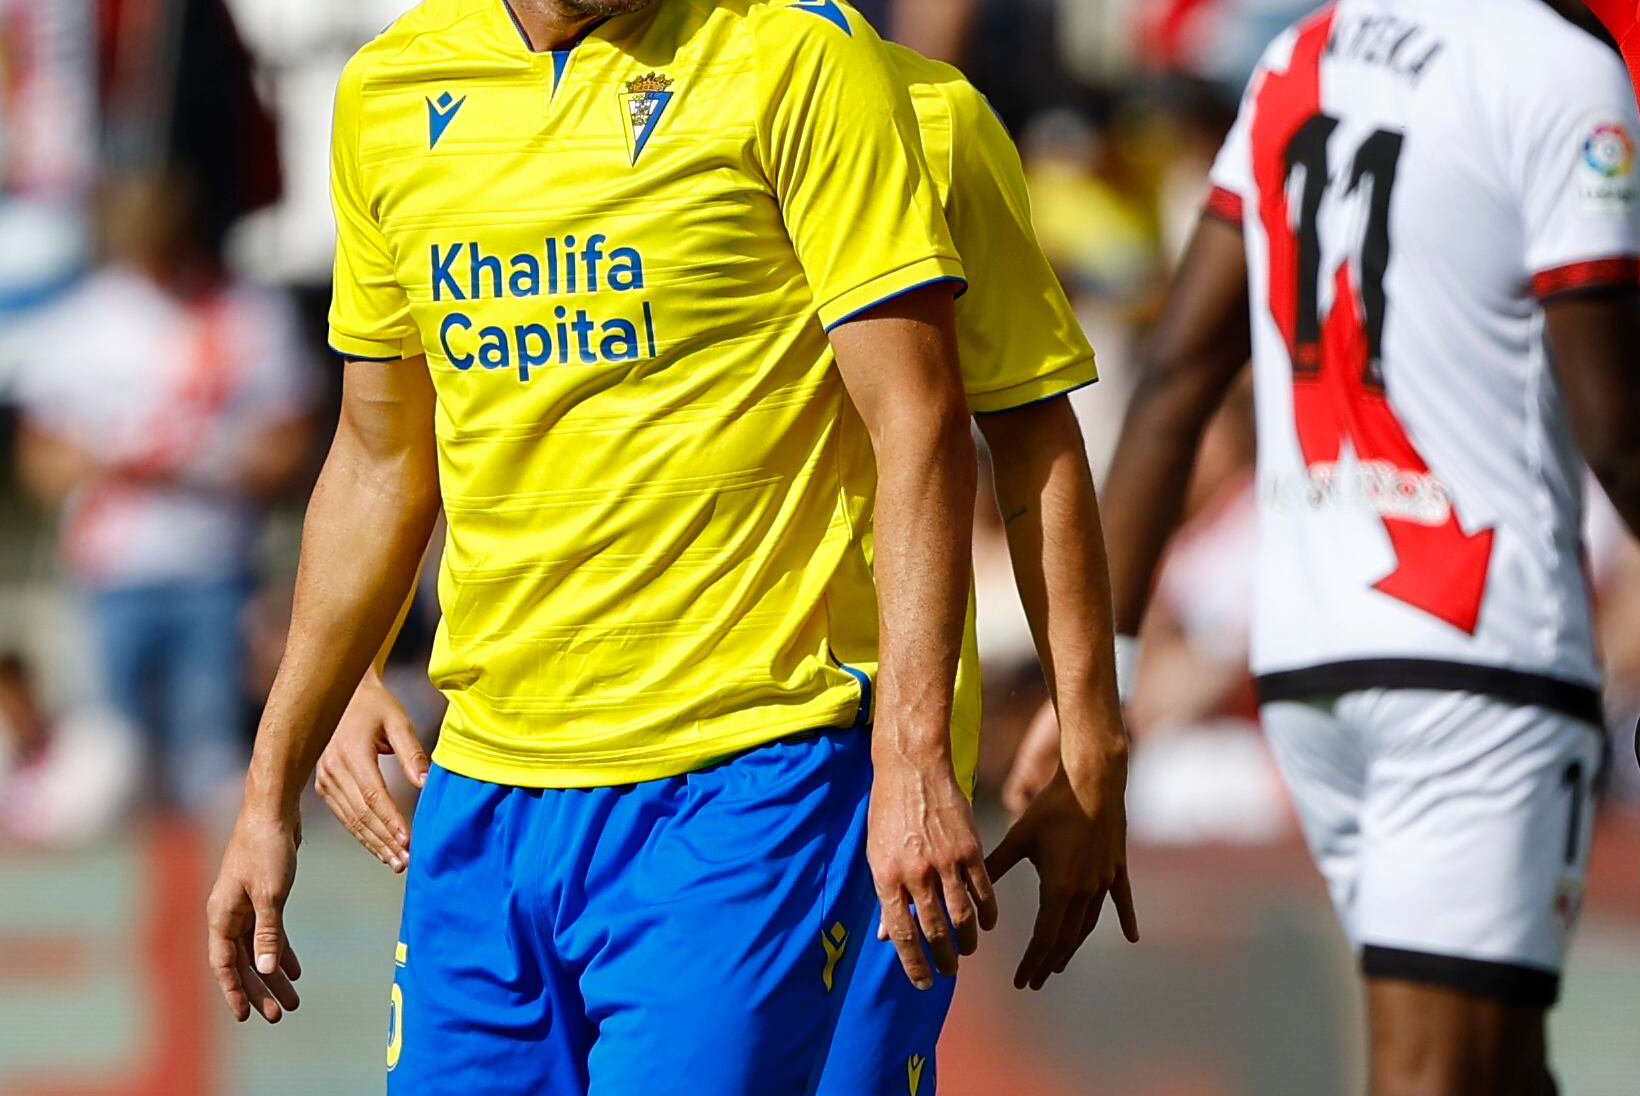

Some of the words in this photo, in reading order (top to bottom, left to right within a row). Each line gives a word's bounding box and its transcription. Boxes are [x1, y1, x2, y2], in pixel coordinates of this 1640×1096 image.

[430, 233, 644, 301] Khalifa
[1283, 112, 1406, 386] 11
[439, 301, 656, 382] Capital
